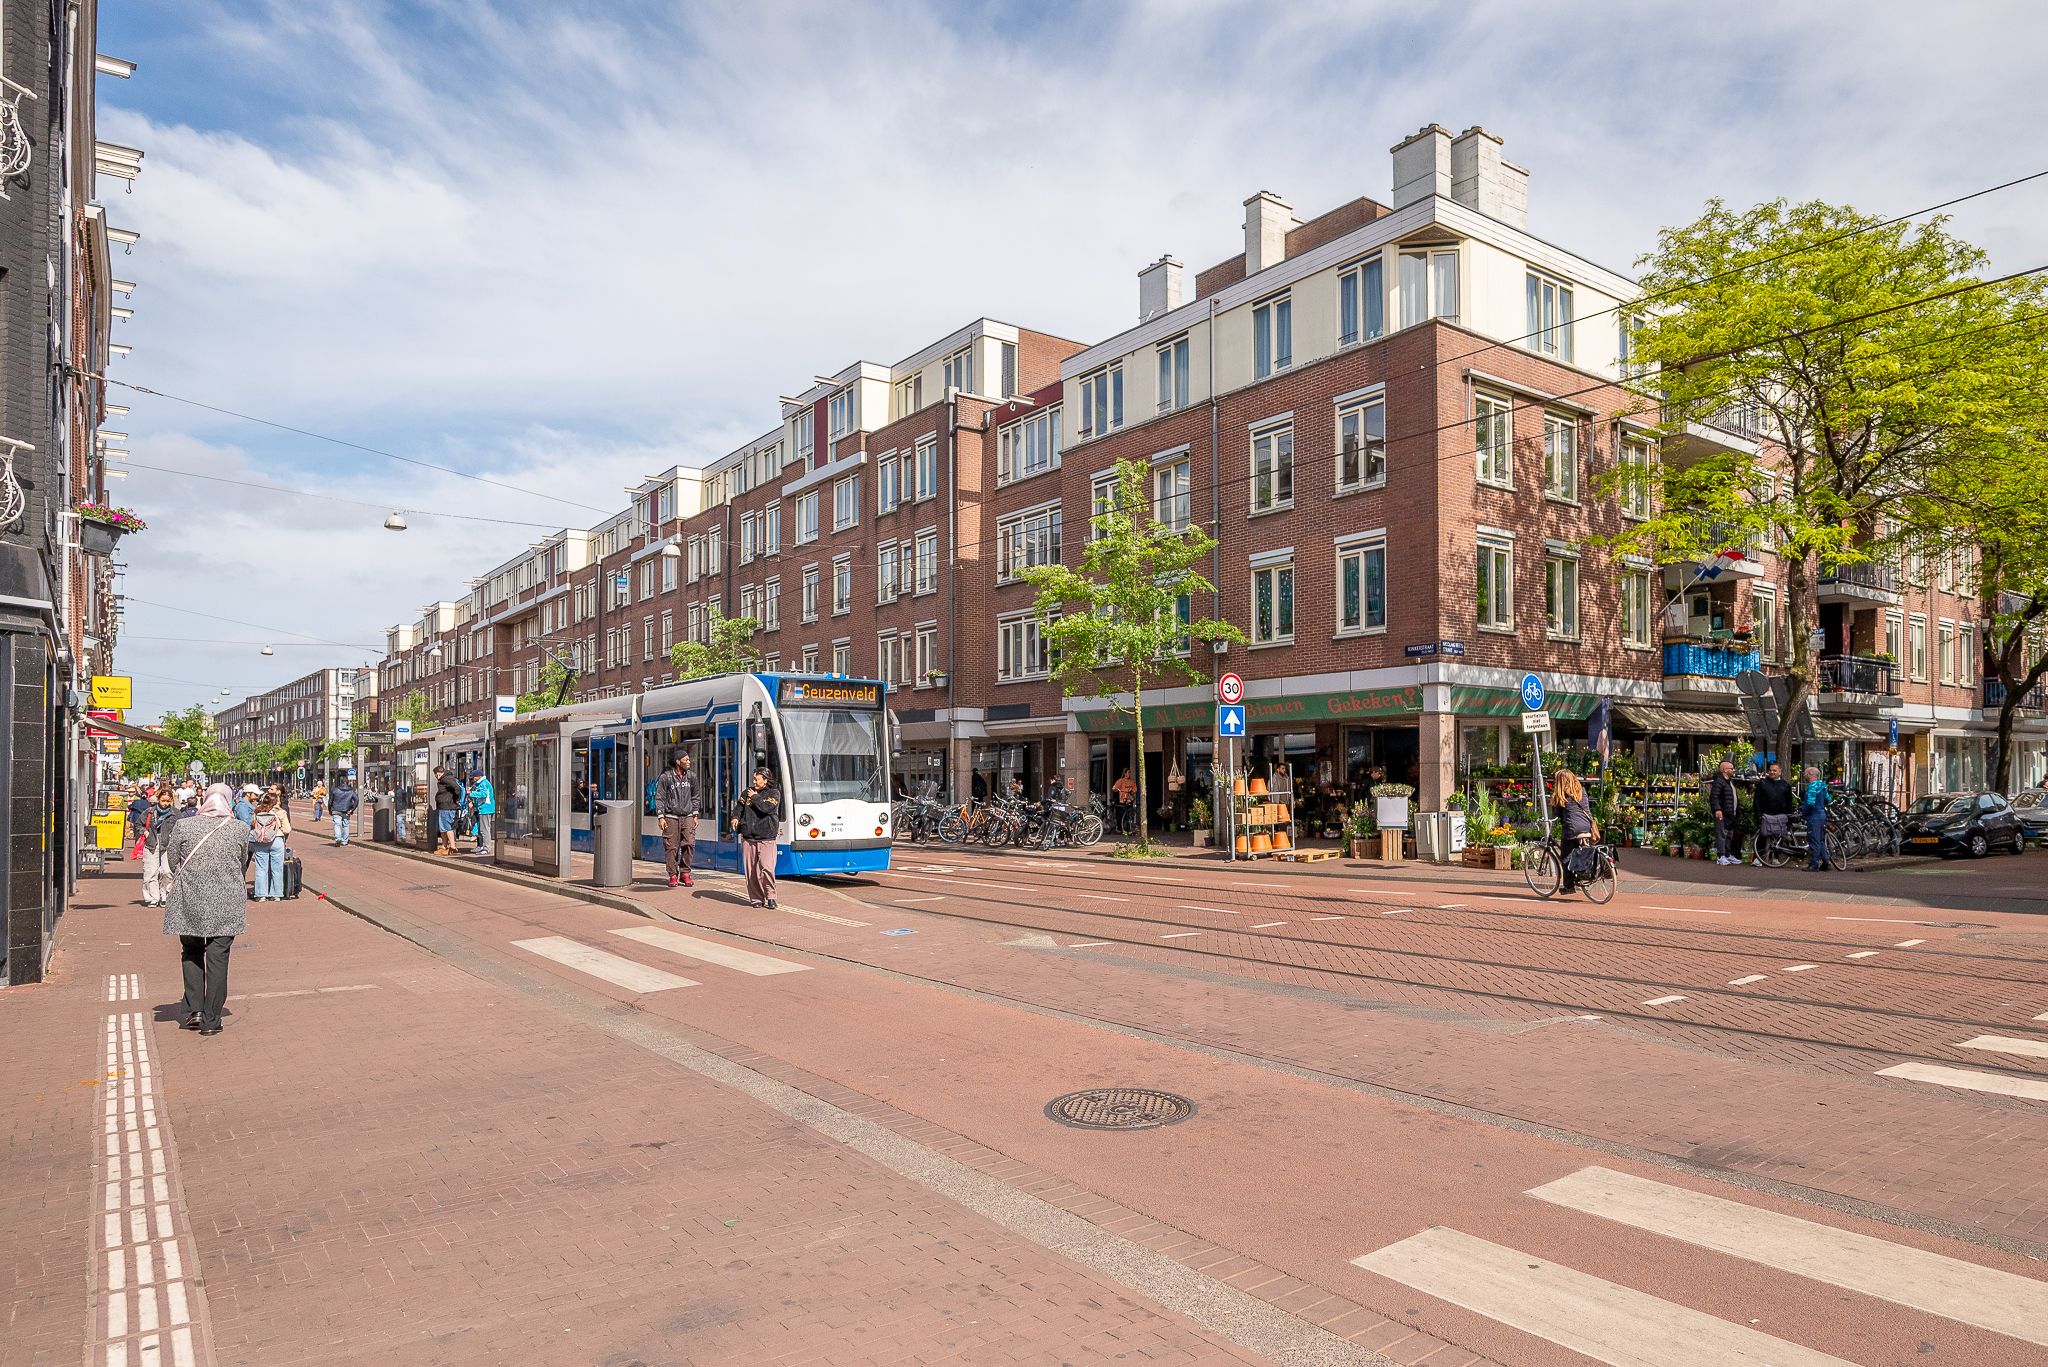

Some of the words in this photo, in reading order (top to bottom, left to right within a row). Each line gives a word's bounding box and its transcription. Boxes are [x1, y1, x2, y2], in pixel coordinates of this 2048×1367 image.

[785, 683, 792, 698] 7
[802, 683, 877, 701] Geuzenveld
[1224, 682, 1240, 694] 30
[1245, 700, 1304, 719] Binnen
[1327, 688, 1416, 715] Gekeken?
